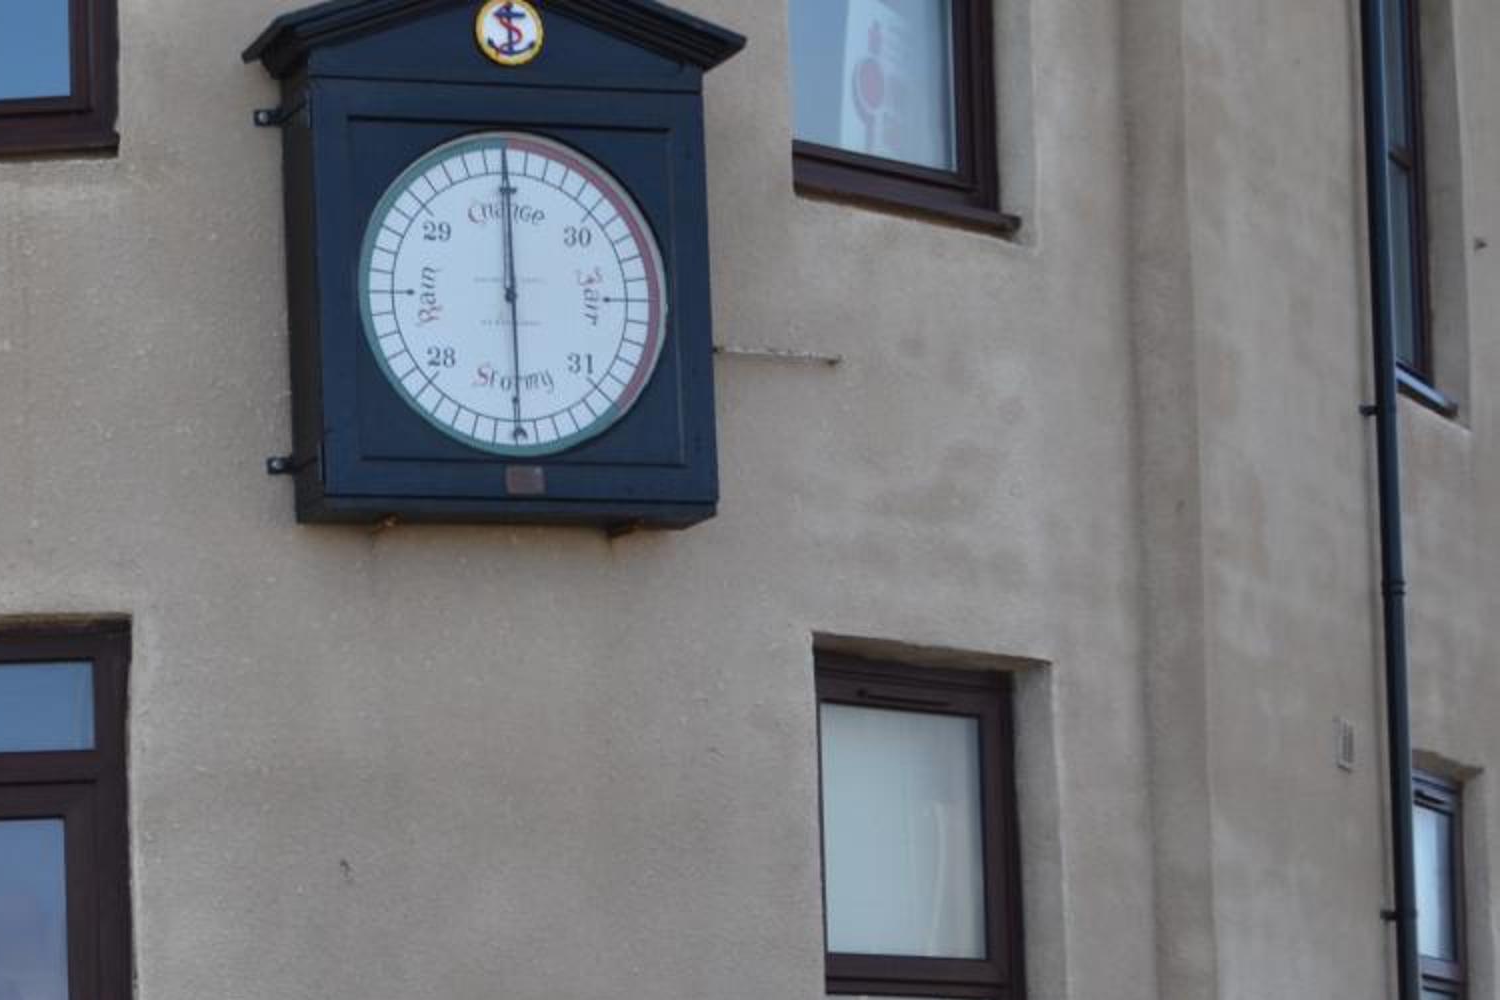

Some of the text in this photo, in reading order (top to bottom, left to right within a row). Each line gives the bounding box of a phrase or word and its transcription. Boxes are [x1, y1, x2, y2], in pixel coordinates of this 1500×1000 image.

[422, 220, 452, 242] 29
[563, 226, 592, 248] 30
[426, 347, 456, 369] 28
[567, 352, 594, 374] 31
